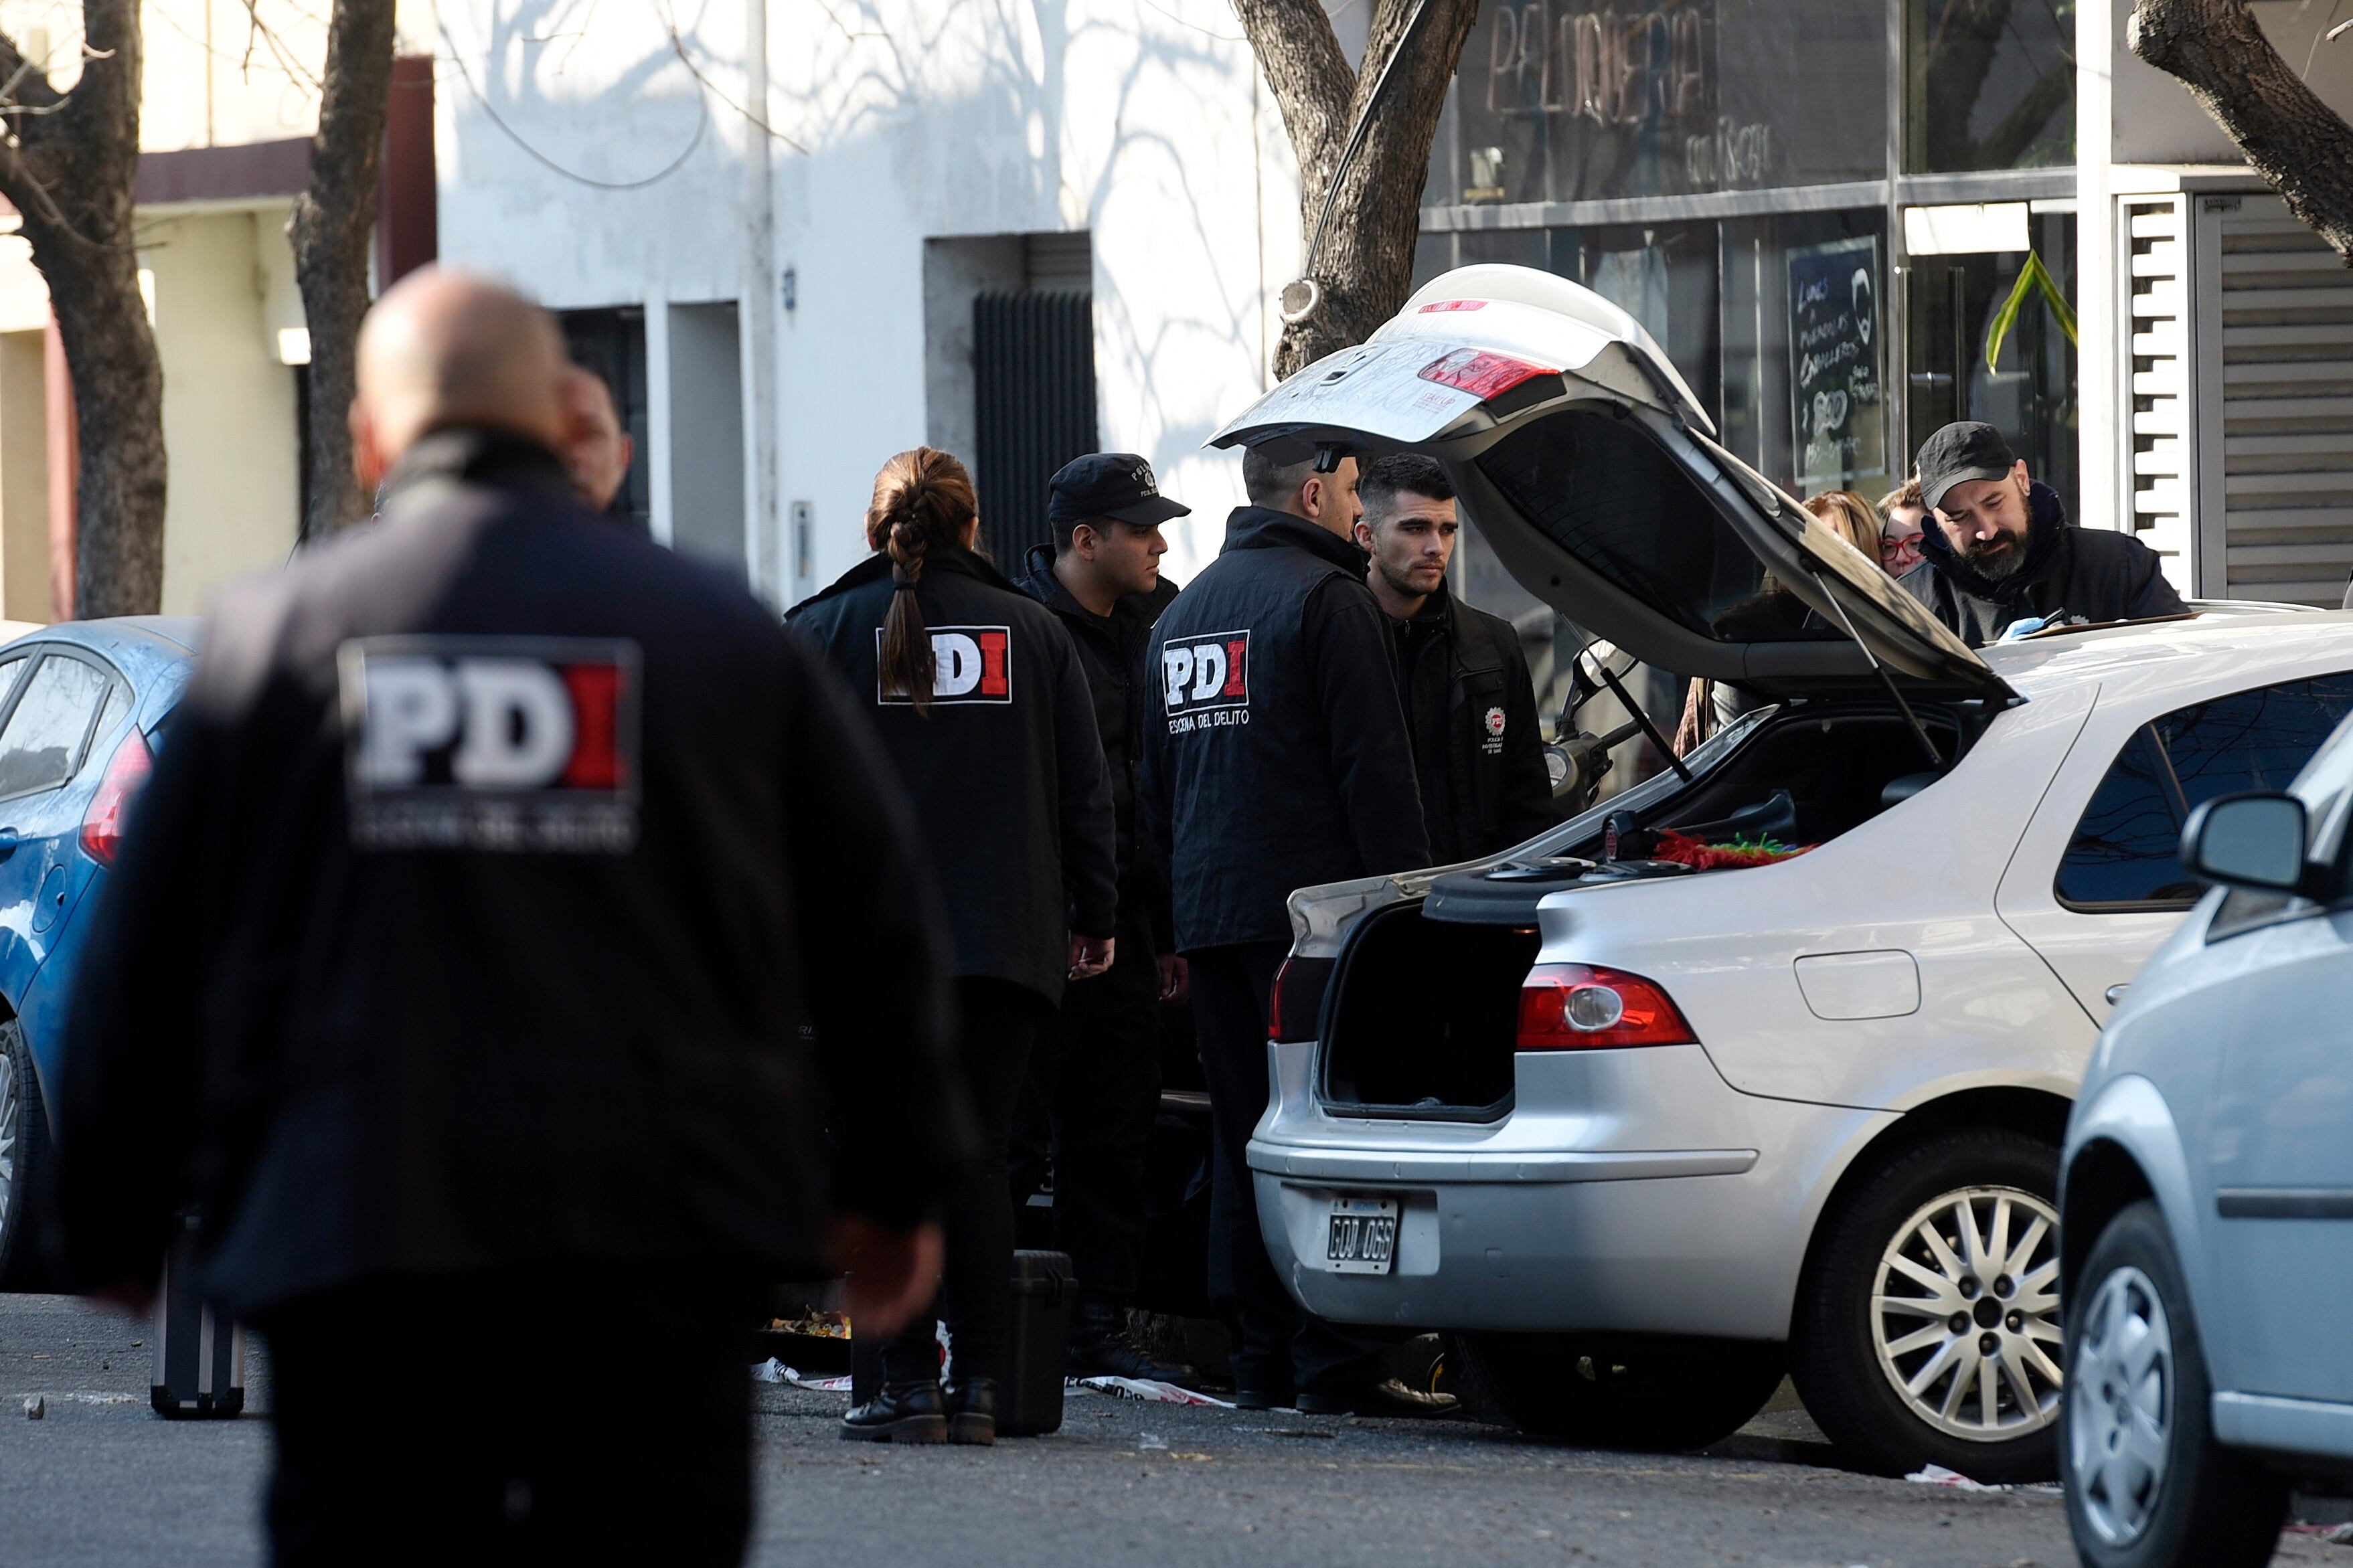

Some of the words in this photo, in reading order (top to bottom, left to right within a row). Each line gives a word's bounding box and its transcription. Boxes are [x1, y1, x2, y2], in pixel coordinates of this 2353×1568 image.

[883, 632, 1006, 696] DI
[1165, 640, 1244, 705] PDI
[355, 656, 630, 790] PDI
[1169, 716, 1196, 735] ESCENA
[1198, 713, 1212, 729] DEL
[1214, 709, 1249, 725] DELITO
